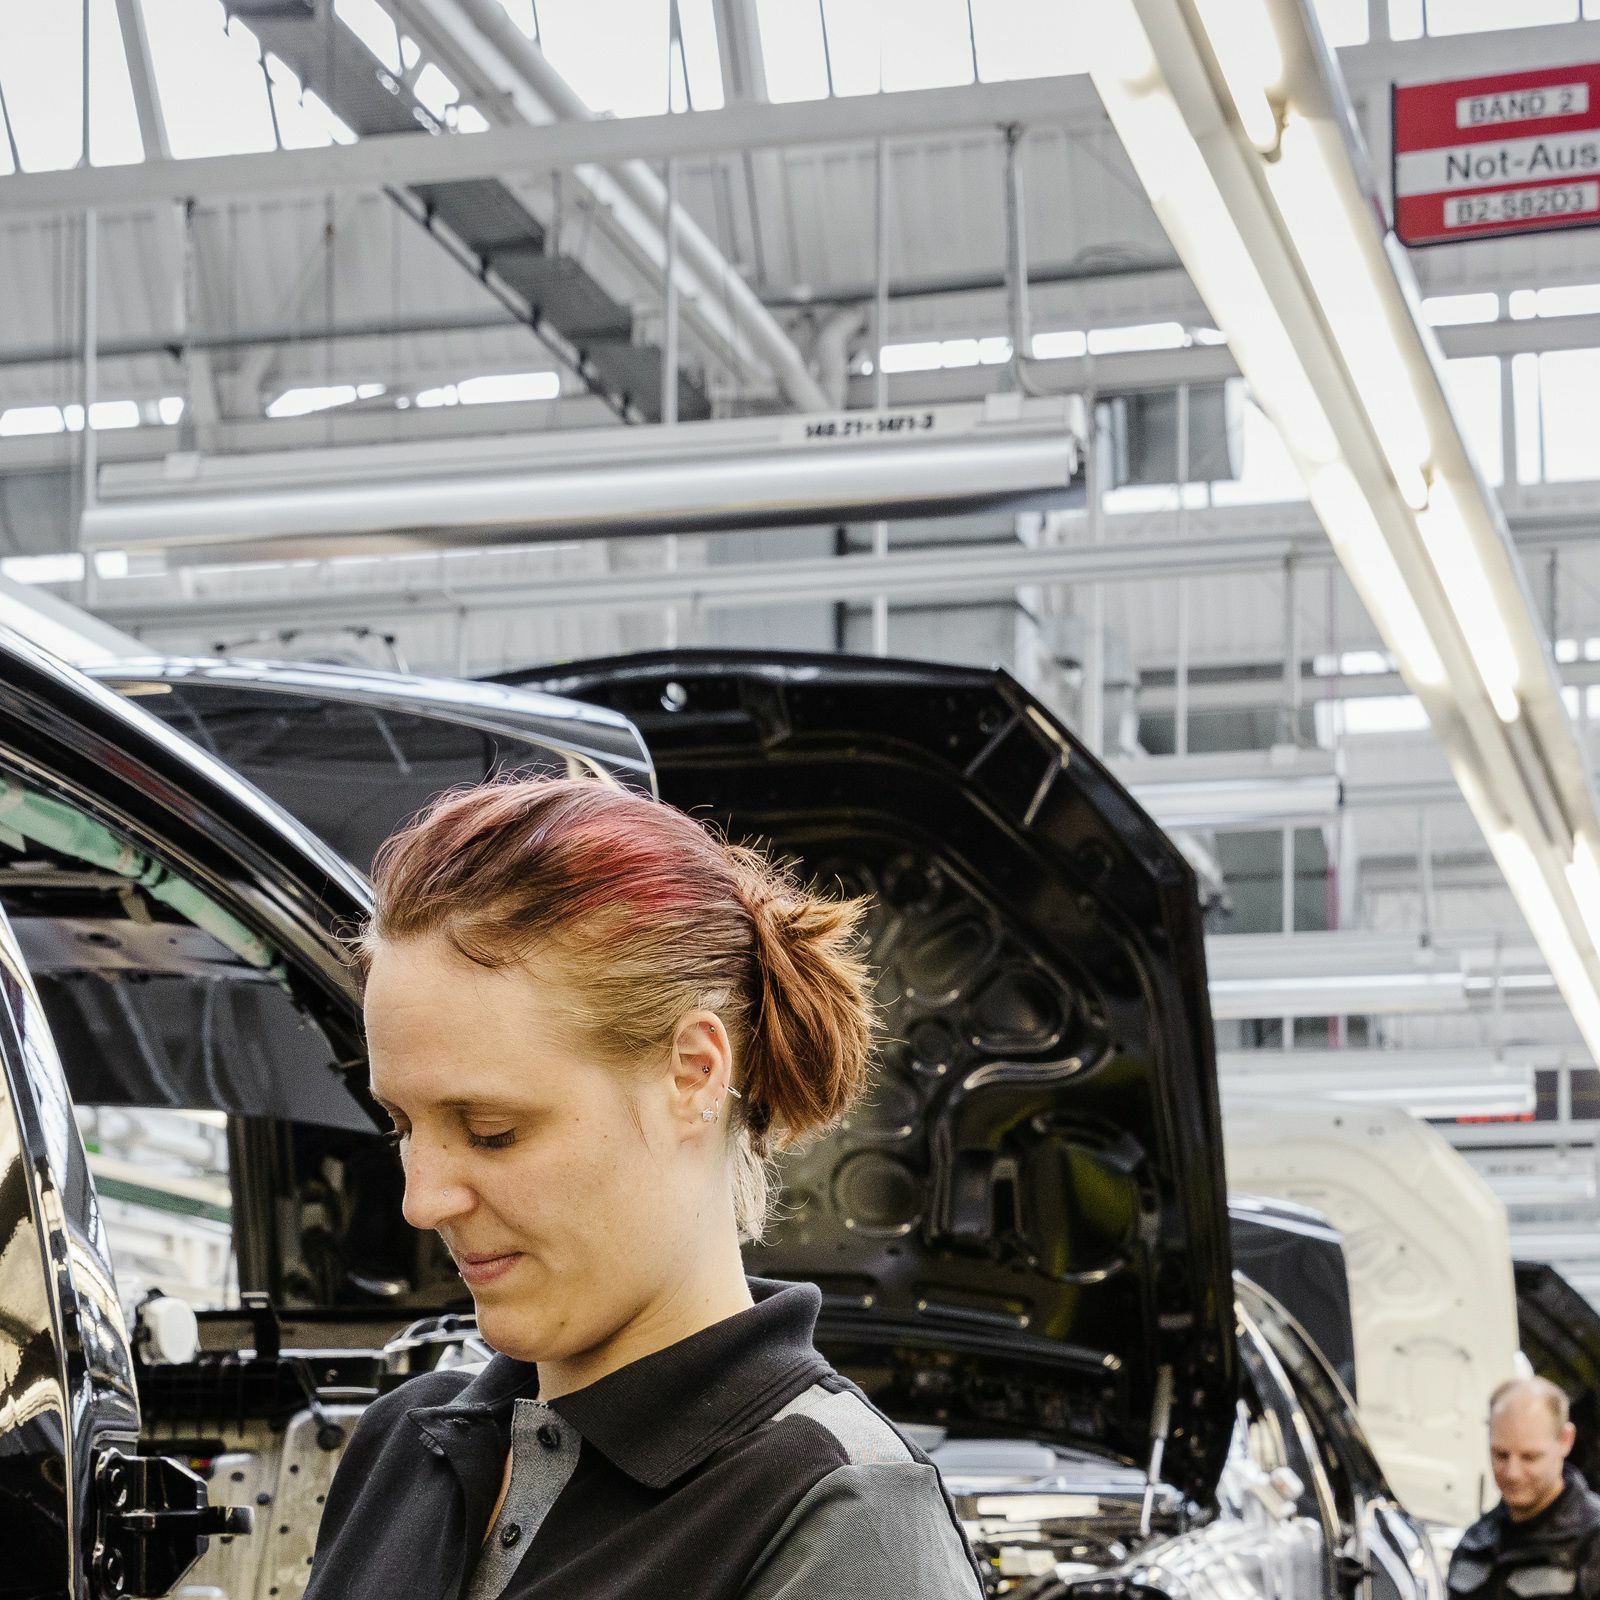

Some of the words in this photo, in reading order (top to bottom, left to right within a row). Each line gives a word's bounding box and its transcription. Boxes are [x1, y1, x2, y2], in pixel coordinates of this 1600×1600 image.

[1470, 92, 1545, 123] BAND
[1559, 88, 1573, 113] 2
[1446, 143, 1598, 182] Not-Aus
